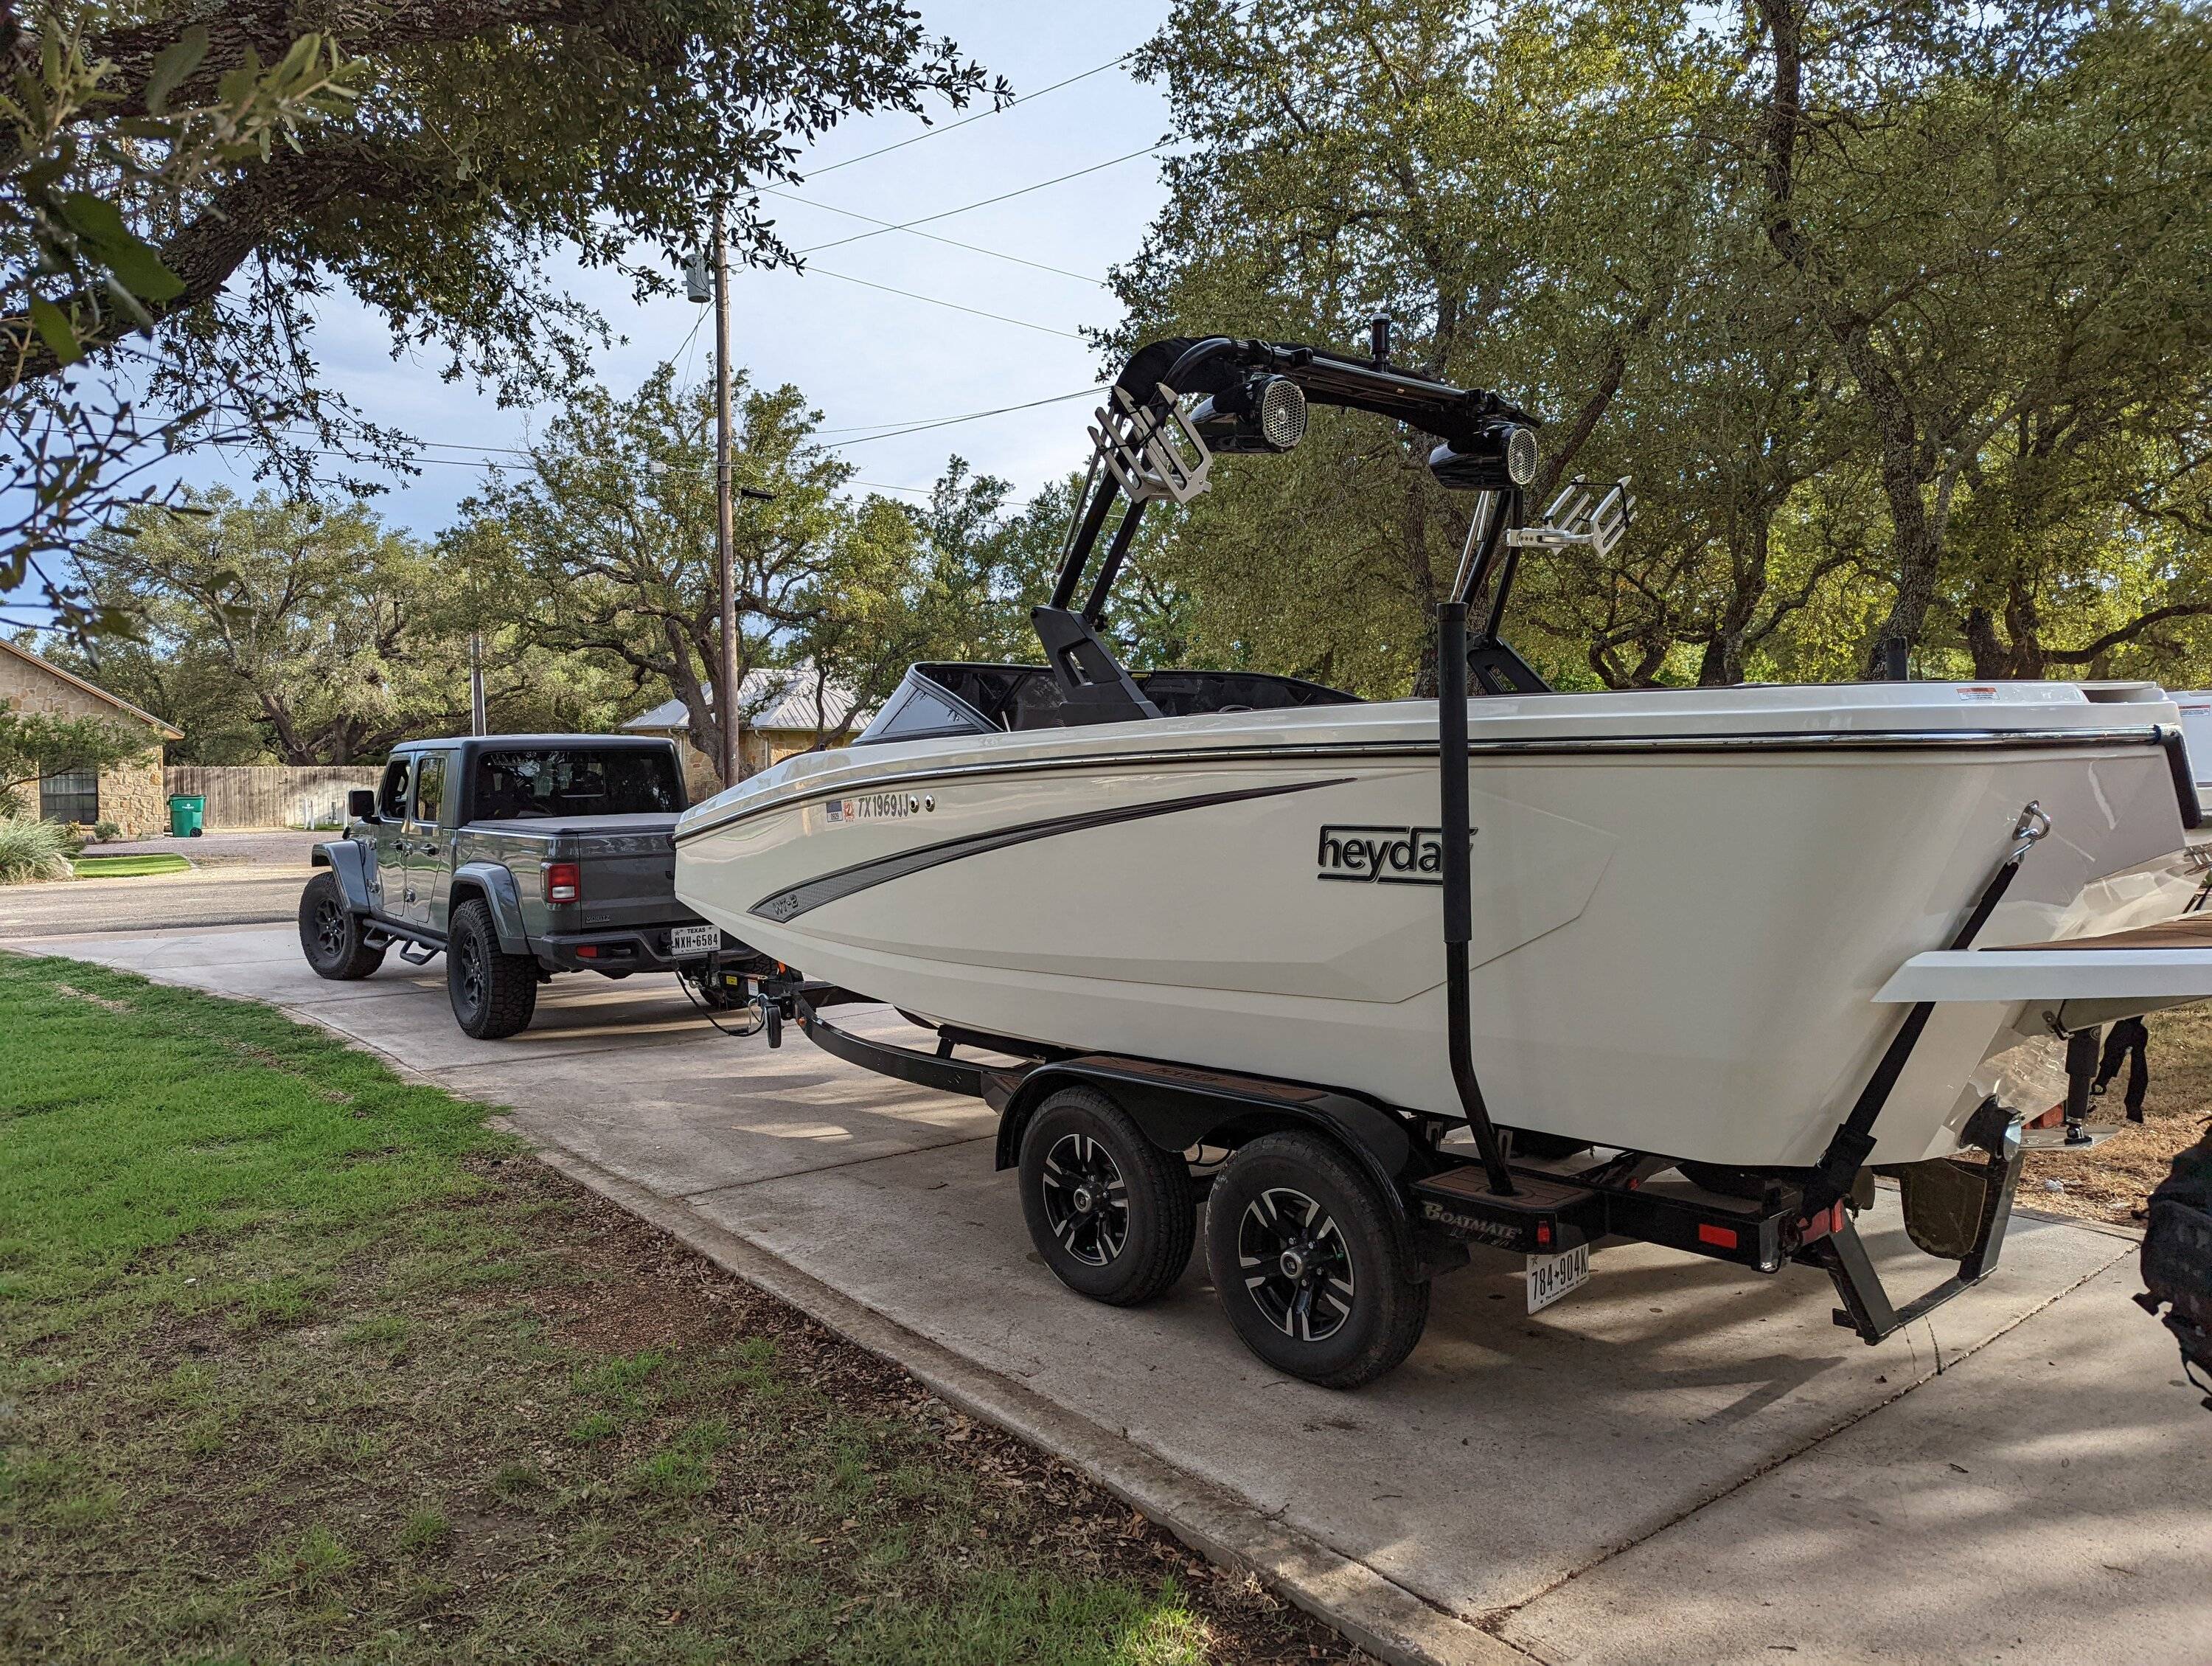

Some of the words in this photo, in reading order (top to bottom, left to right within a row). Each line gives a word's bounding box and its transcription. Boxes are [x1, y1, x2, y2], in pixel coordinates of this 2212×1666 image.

[1318, 824, 1478, 886] heyda
[773, 894, 798, 915] WT-2
[1421, 1201, 1517, 1240] BOATMATE
